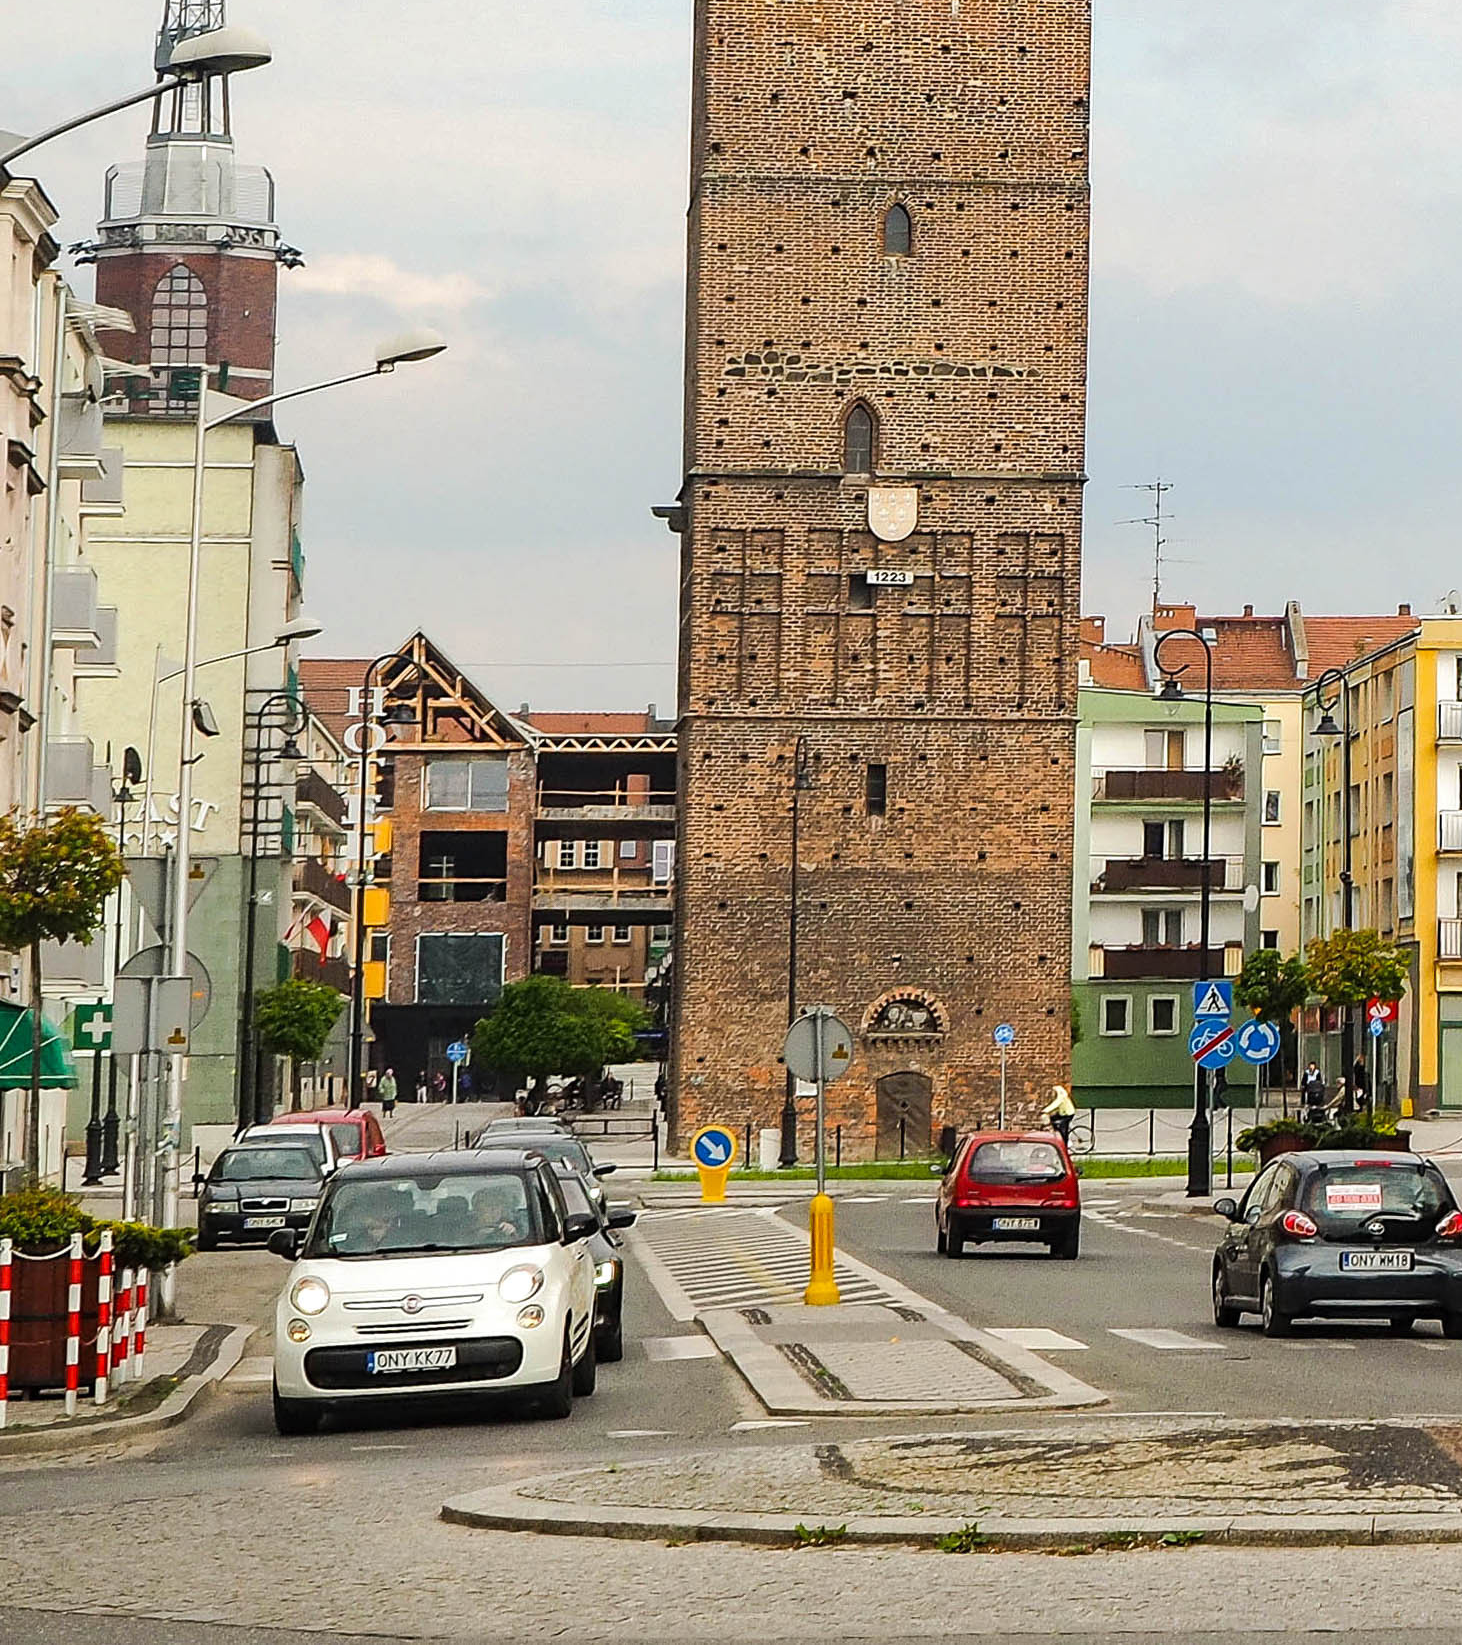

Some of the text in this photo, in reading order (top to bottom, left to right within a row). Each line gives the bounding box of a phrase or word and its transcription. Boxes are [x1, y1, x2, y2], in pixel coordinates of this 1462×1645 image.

[874, 572, 906, 583] 1223
[341, 686, 388, 861] HOTEL
[1350, 1255, 1408, 1267] ONY WM18
[377, 1349, 453, 1368] ONY KK77
